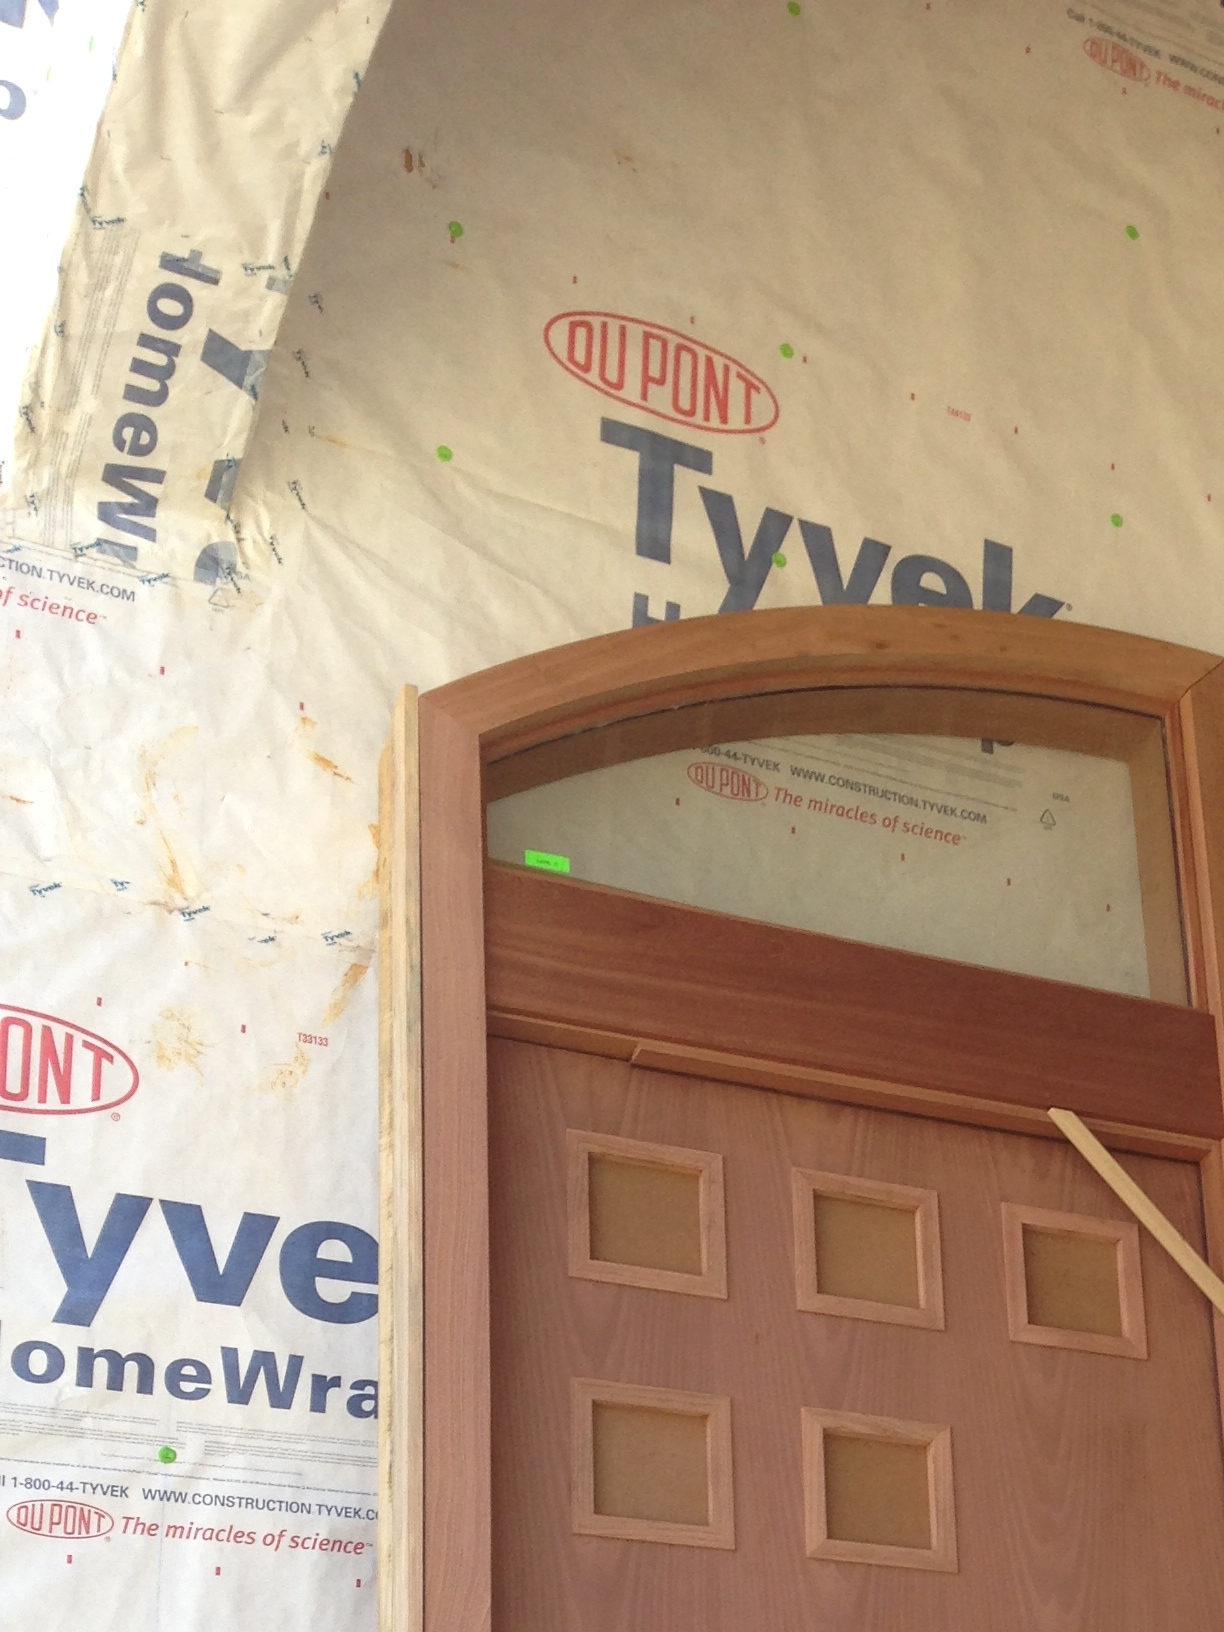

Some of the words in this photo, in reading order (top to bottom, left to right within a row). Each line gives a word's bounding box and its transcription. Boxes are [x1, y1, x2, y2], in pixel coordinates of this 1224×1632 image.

[17, 593, 98, 625] science
[774, 786, 803, 808] The
[807, 799, 877, 825] miracles
[882, 814, 899, 833] of
[902, 819, 962, 847] science
[11, 1475, 130, 1499] 1-800-44-TYVEK
[121, 1516, 158, 1537] The
[165, 1521, 256, 1546] miracles
[262, 1528, 287, 1552] of
[289, 1533, 366, 1556] science
